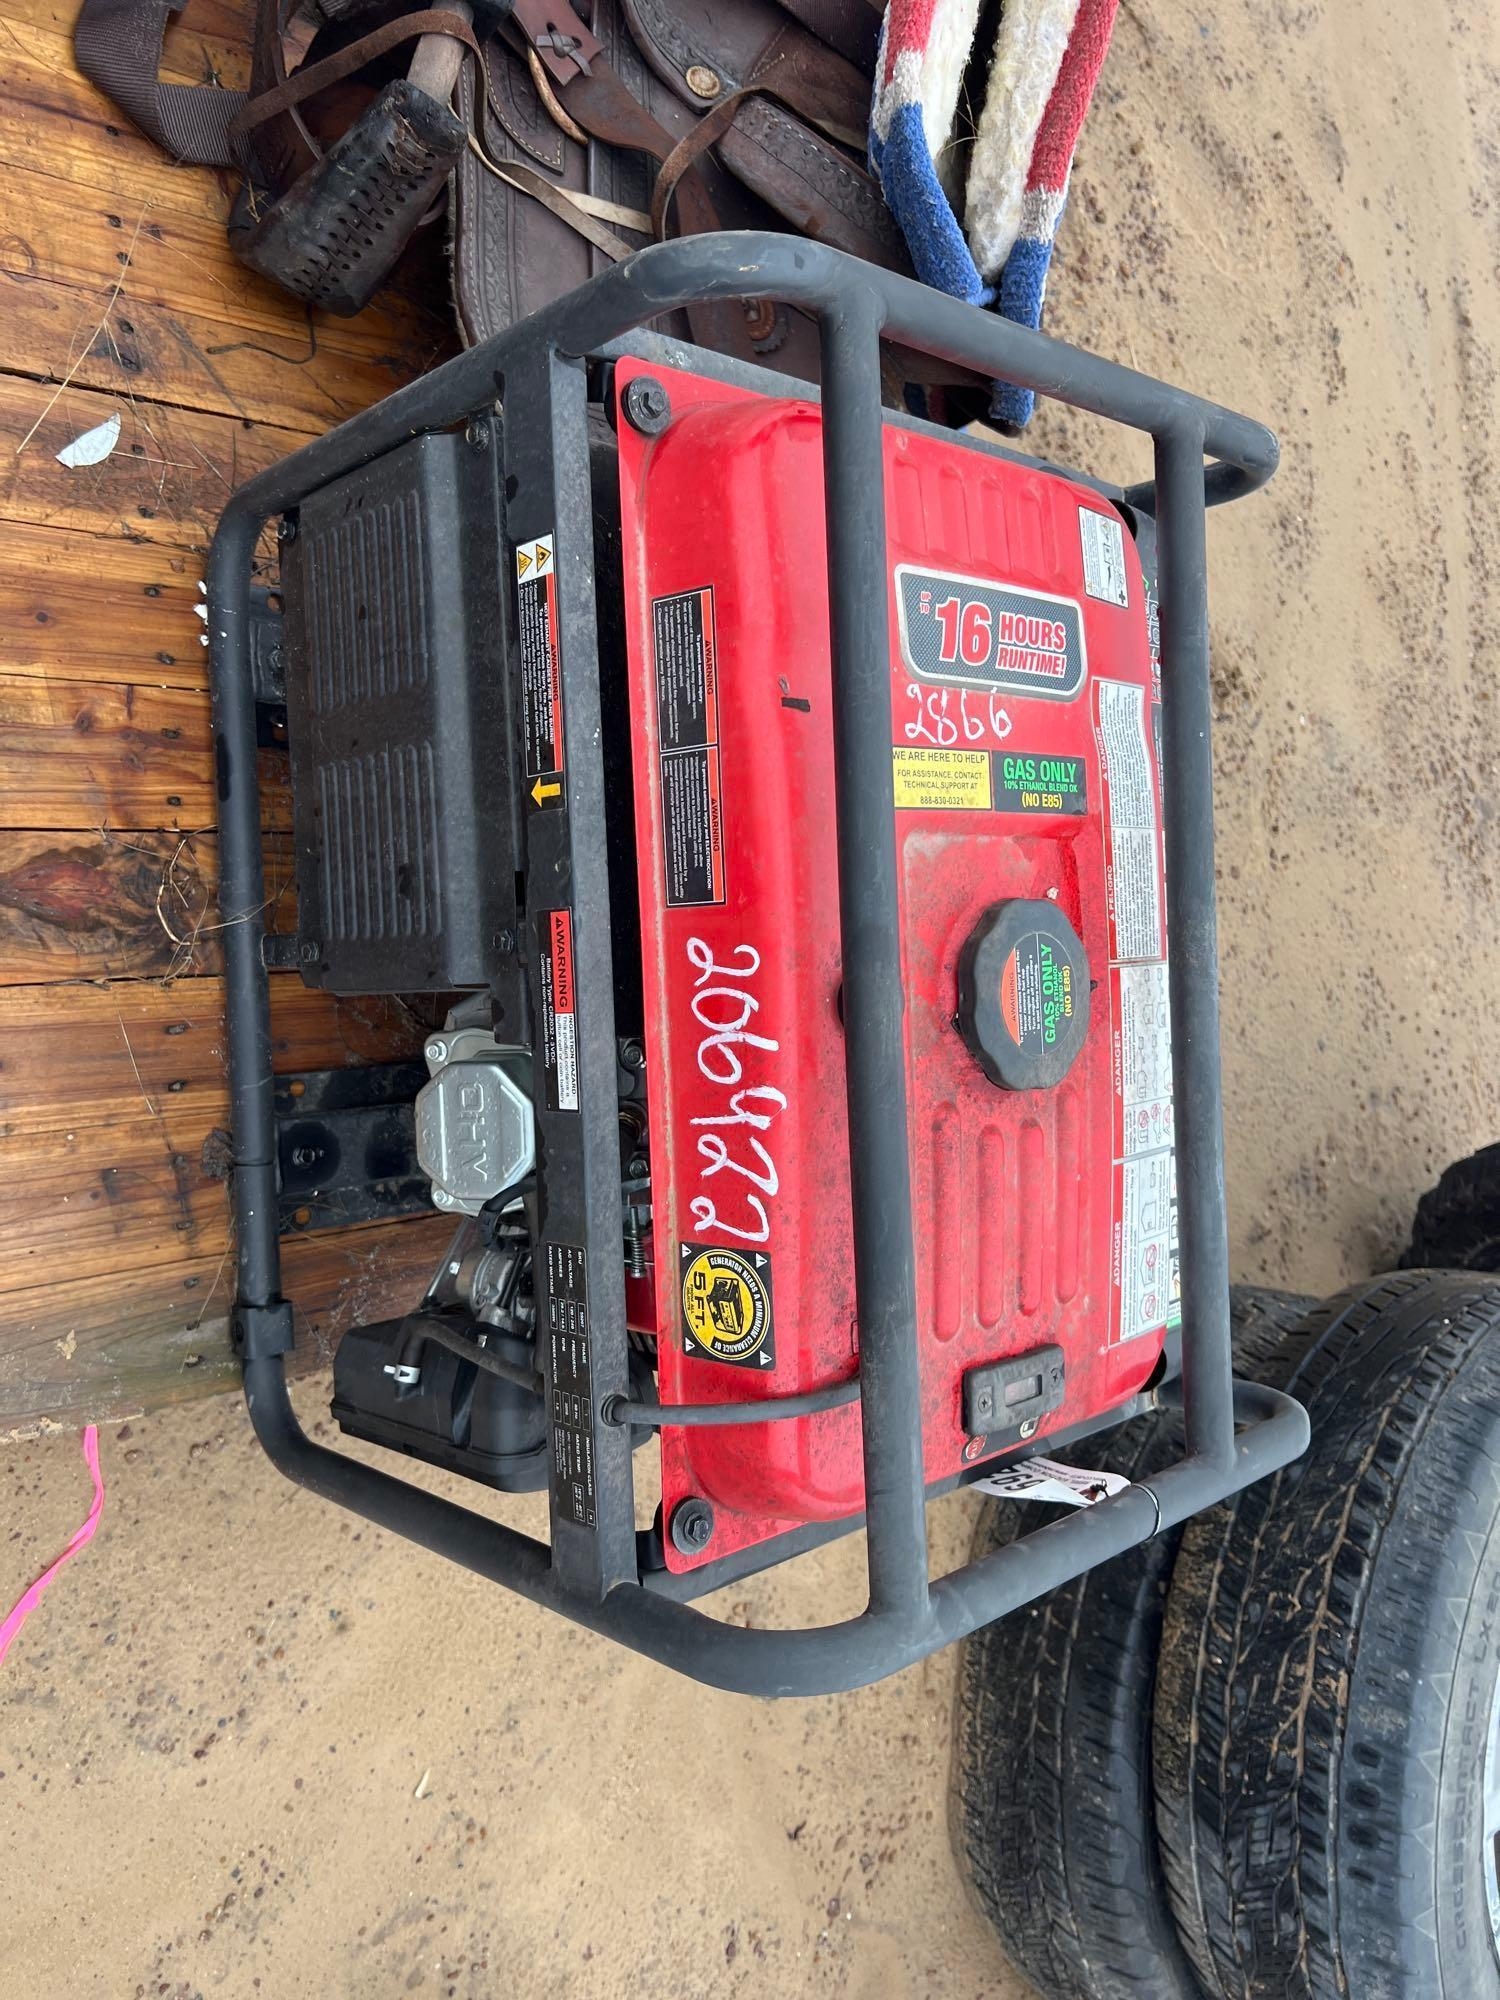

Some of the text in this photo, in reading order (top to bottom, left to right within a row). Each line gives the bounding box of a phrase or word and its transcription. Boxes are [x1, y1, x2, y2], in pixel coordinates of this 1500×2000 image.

[920, 603, 930, 614] TO
[921, 591, 931, 601] UP
[935, 597, 992, 666] 16
[1000, 612, 1066, 652] HOURS
[705, 643, 714, 695] WARNING
[995, 644, 1067, 678] RUNTIME!
[893, 751, 985, 763] WE ARE HERE TO HELP
[1096, 726, 1107, 770] DANGER
[904, 781, 978, 790] TECHNICAL SUPPORT AT
[1003, 758, 1076, 782] GAS ONLY
[1004, 780, 1078, 793] 10% ETHANOL BLEND OK
[1022, 792, 1062, 809] (NO E85)
[711, 802, 720, 851] WARNING
[1106, 864, 1114, 911] PELIGRO
[556, 929, 568, 1007] WARNING
[1059, 972, 1064, 982] OK
[1041, 944, 1056, 1043] GAS ONLY
[1063, 966, 1073, 1017] (NO E85)
[541, 985, 549, 1041] non-replaceable
[1114, 1031, 1122, 1086] DANGER
[458, 1082, 487, 1181] OHV
[710, 1256, 743, 1273] GENERATOR
[1114, 1221, 1122, 1278] DANGER
[694, 1271, 706, 1329] 5 FT.
[741, 1270, 757, 1292] NEEDS
[750, 1301, 763, 1338] MINIMUM
[714, 1341, 721, 1350] OF
[722, 1336, 753, 1353] CLEARANCE
